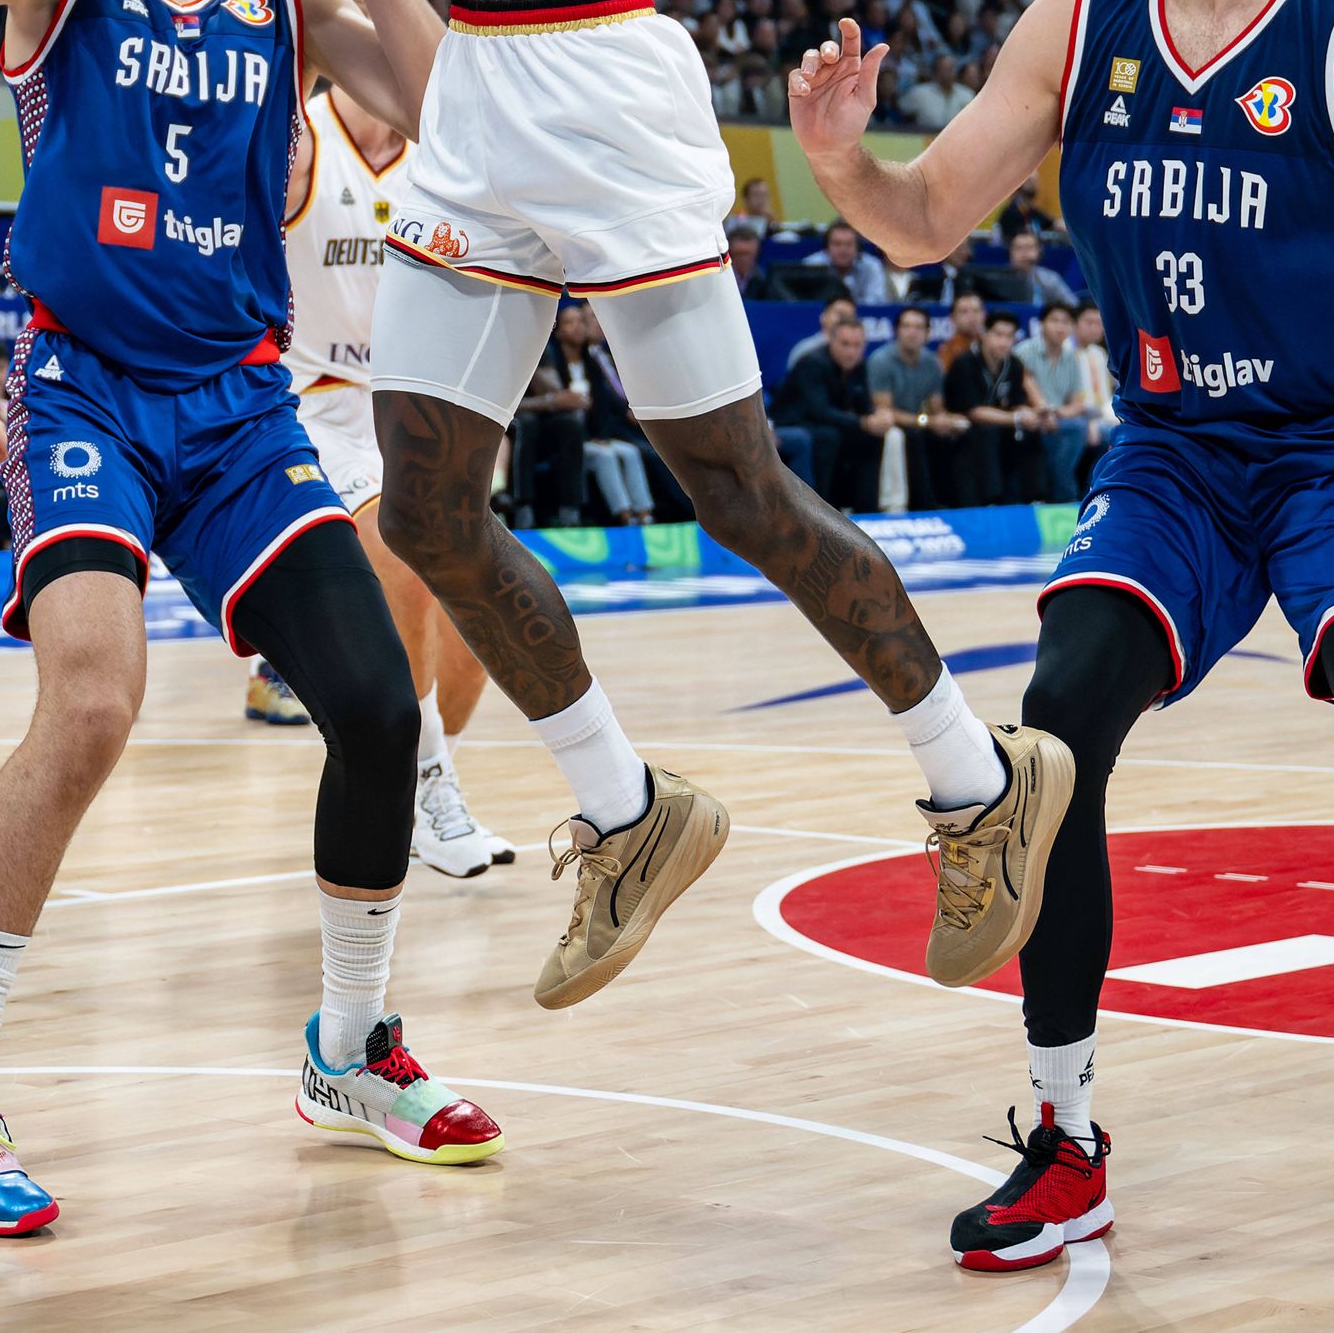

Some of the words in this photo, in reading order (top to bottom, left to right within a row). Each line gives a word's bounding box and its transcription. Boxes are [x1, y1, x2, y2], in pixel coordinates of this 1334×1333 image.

[116, 37, 268, 107] SRBIJA
[1104, 111, 1132, 128] PEAK
[164, 125, 191, 183] 5
[1103, 159, 1268, 230] SRBIJA
[163, 209, 244, 257] trigla
[1155, 250, 1205, 315] 33
[53, 482, 100, 503] mts
